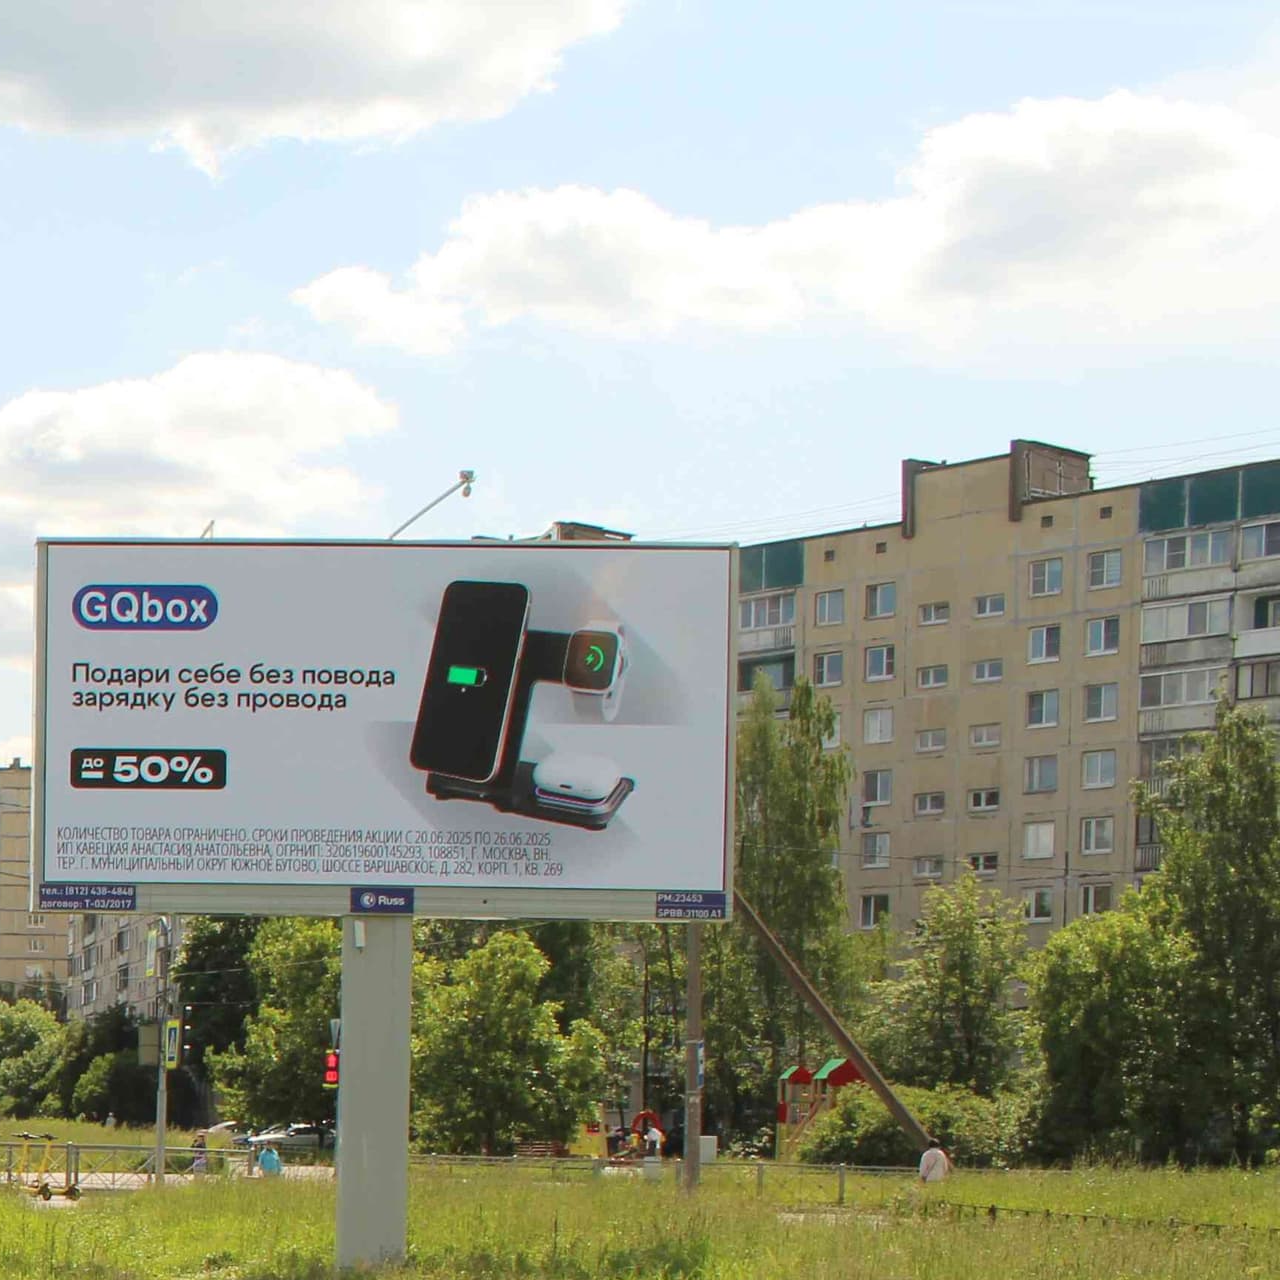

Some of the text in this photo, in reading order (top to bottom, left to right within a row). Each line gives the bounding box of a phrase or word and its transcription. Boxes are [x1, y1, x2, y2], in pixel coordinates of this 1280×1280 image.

[80, 591, 208, 623] GQbox
[72, 663, 396, 687] Подари себе без повода
[72, 687, 347, 713] зарядку без провода
[57, 826, 128, 840] КОЛИЧЕСТВО
[131, 827, 171, 841] ТОВАРА
[252, 828, 288, 841] СРОКИ
[291, 829, 362, 843] ПРОВЕДЕНИЯ
[365, 830, 402, 844] АКЦИИ
[405, 830, 413, 844] С
[415, 831, 473, 845] 20.06.2025
[475, 832, 491, 845] ПО
[57, 842, 73, 855] ИП
[76, 842, 129, 857] КАВЕЦКАЯ
[131, 843, 192, 856] АНАСТАСИЯ
[92, 856, 193, 872] МУНИЦИПАЛЬНЫЙ
[197, 858, 229, 871] ОКРУГ
[231, 858, 272, 872] ЮЖНОЕ
[322, 860, 360, 873] ШОССЕ
[544, 863, 563, 876] 269
[378, 896, 405, 905] Russ
